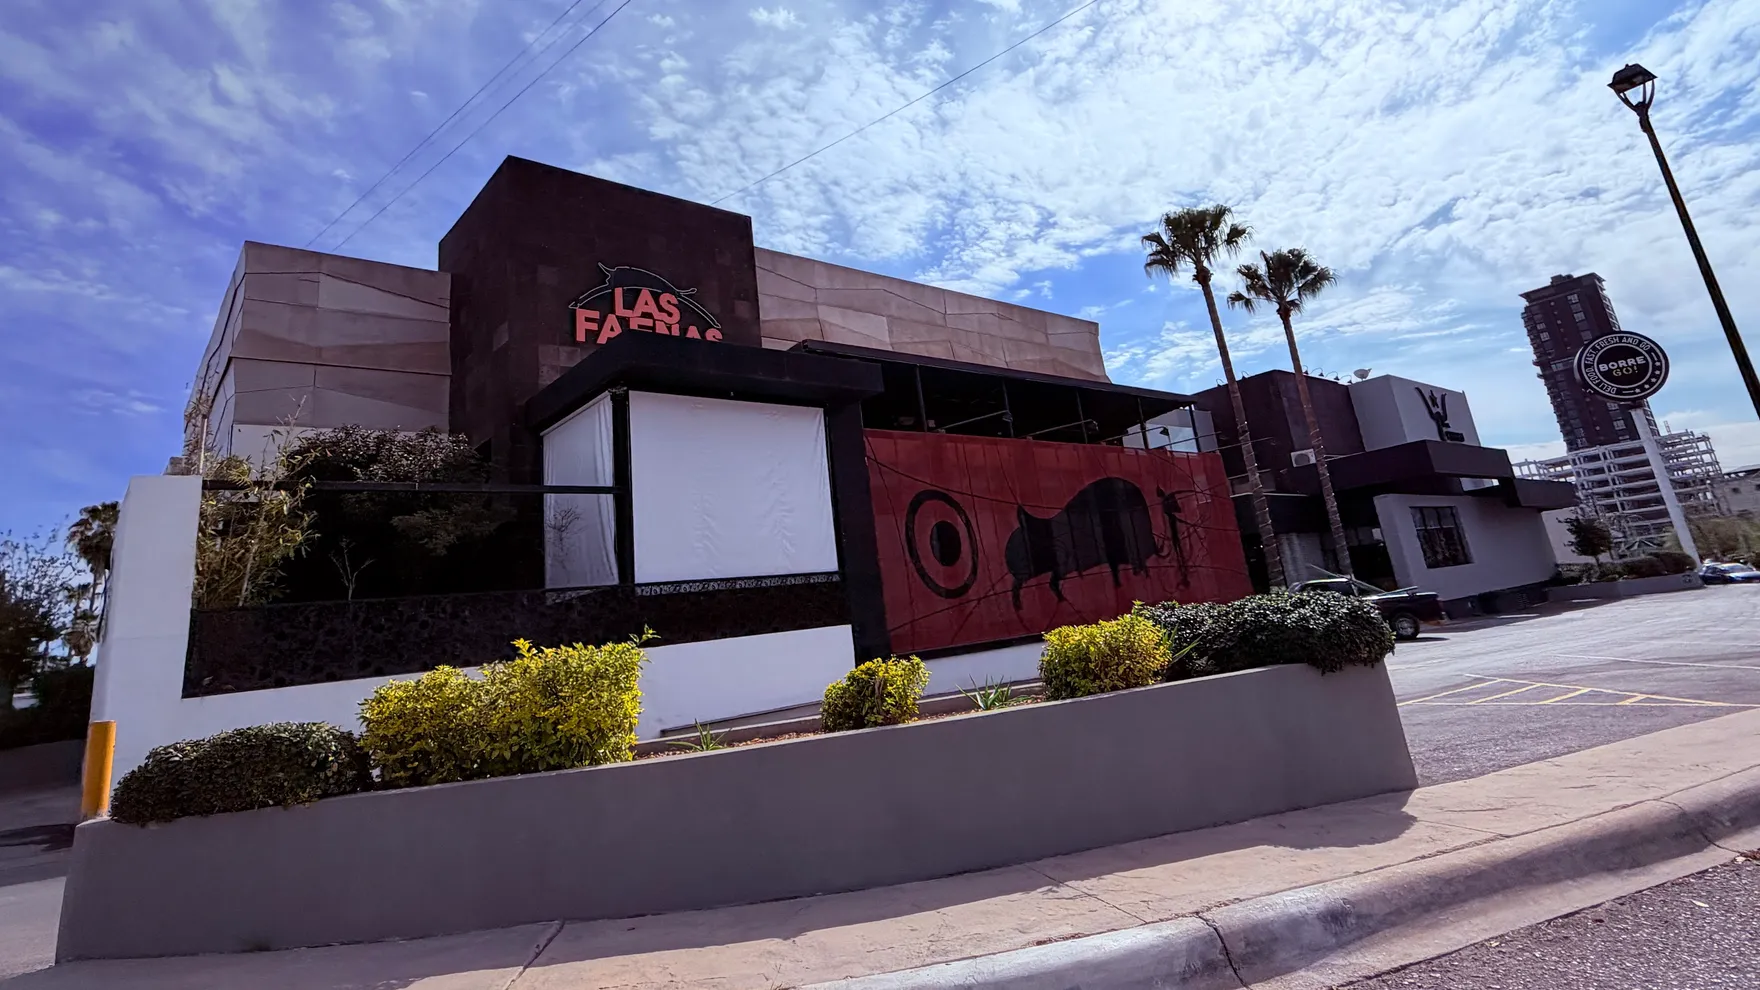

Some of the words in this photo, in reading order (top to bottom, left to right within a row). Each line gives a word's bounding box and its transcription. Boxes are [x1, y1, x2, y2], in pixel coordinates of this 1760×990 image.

[614, 287, 681, 325] LAS
[1596, 336, 1620, 350] FRESH
[1621, 336, 1639, 345] AND
[1639, 341, 1651, 351] GO
[1598, 356, 1646, 372] BORRE
[1612, 365, 1638, 377] GO!
[1599, 382, 1617, 394] DELI
